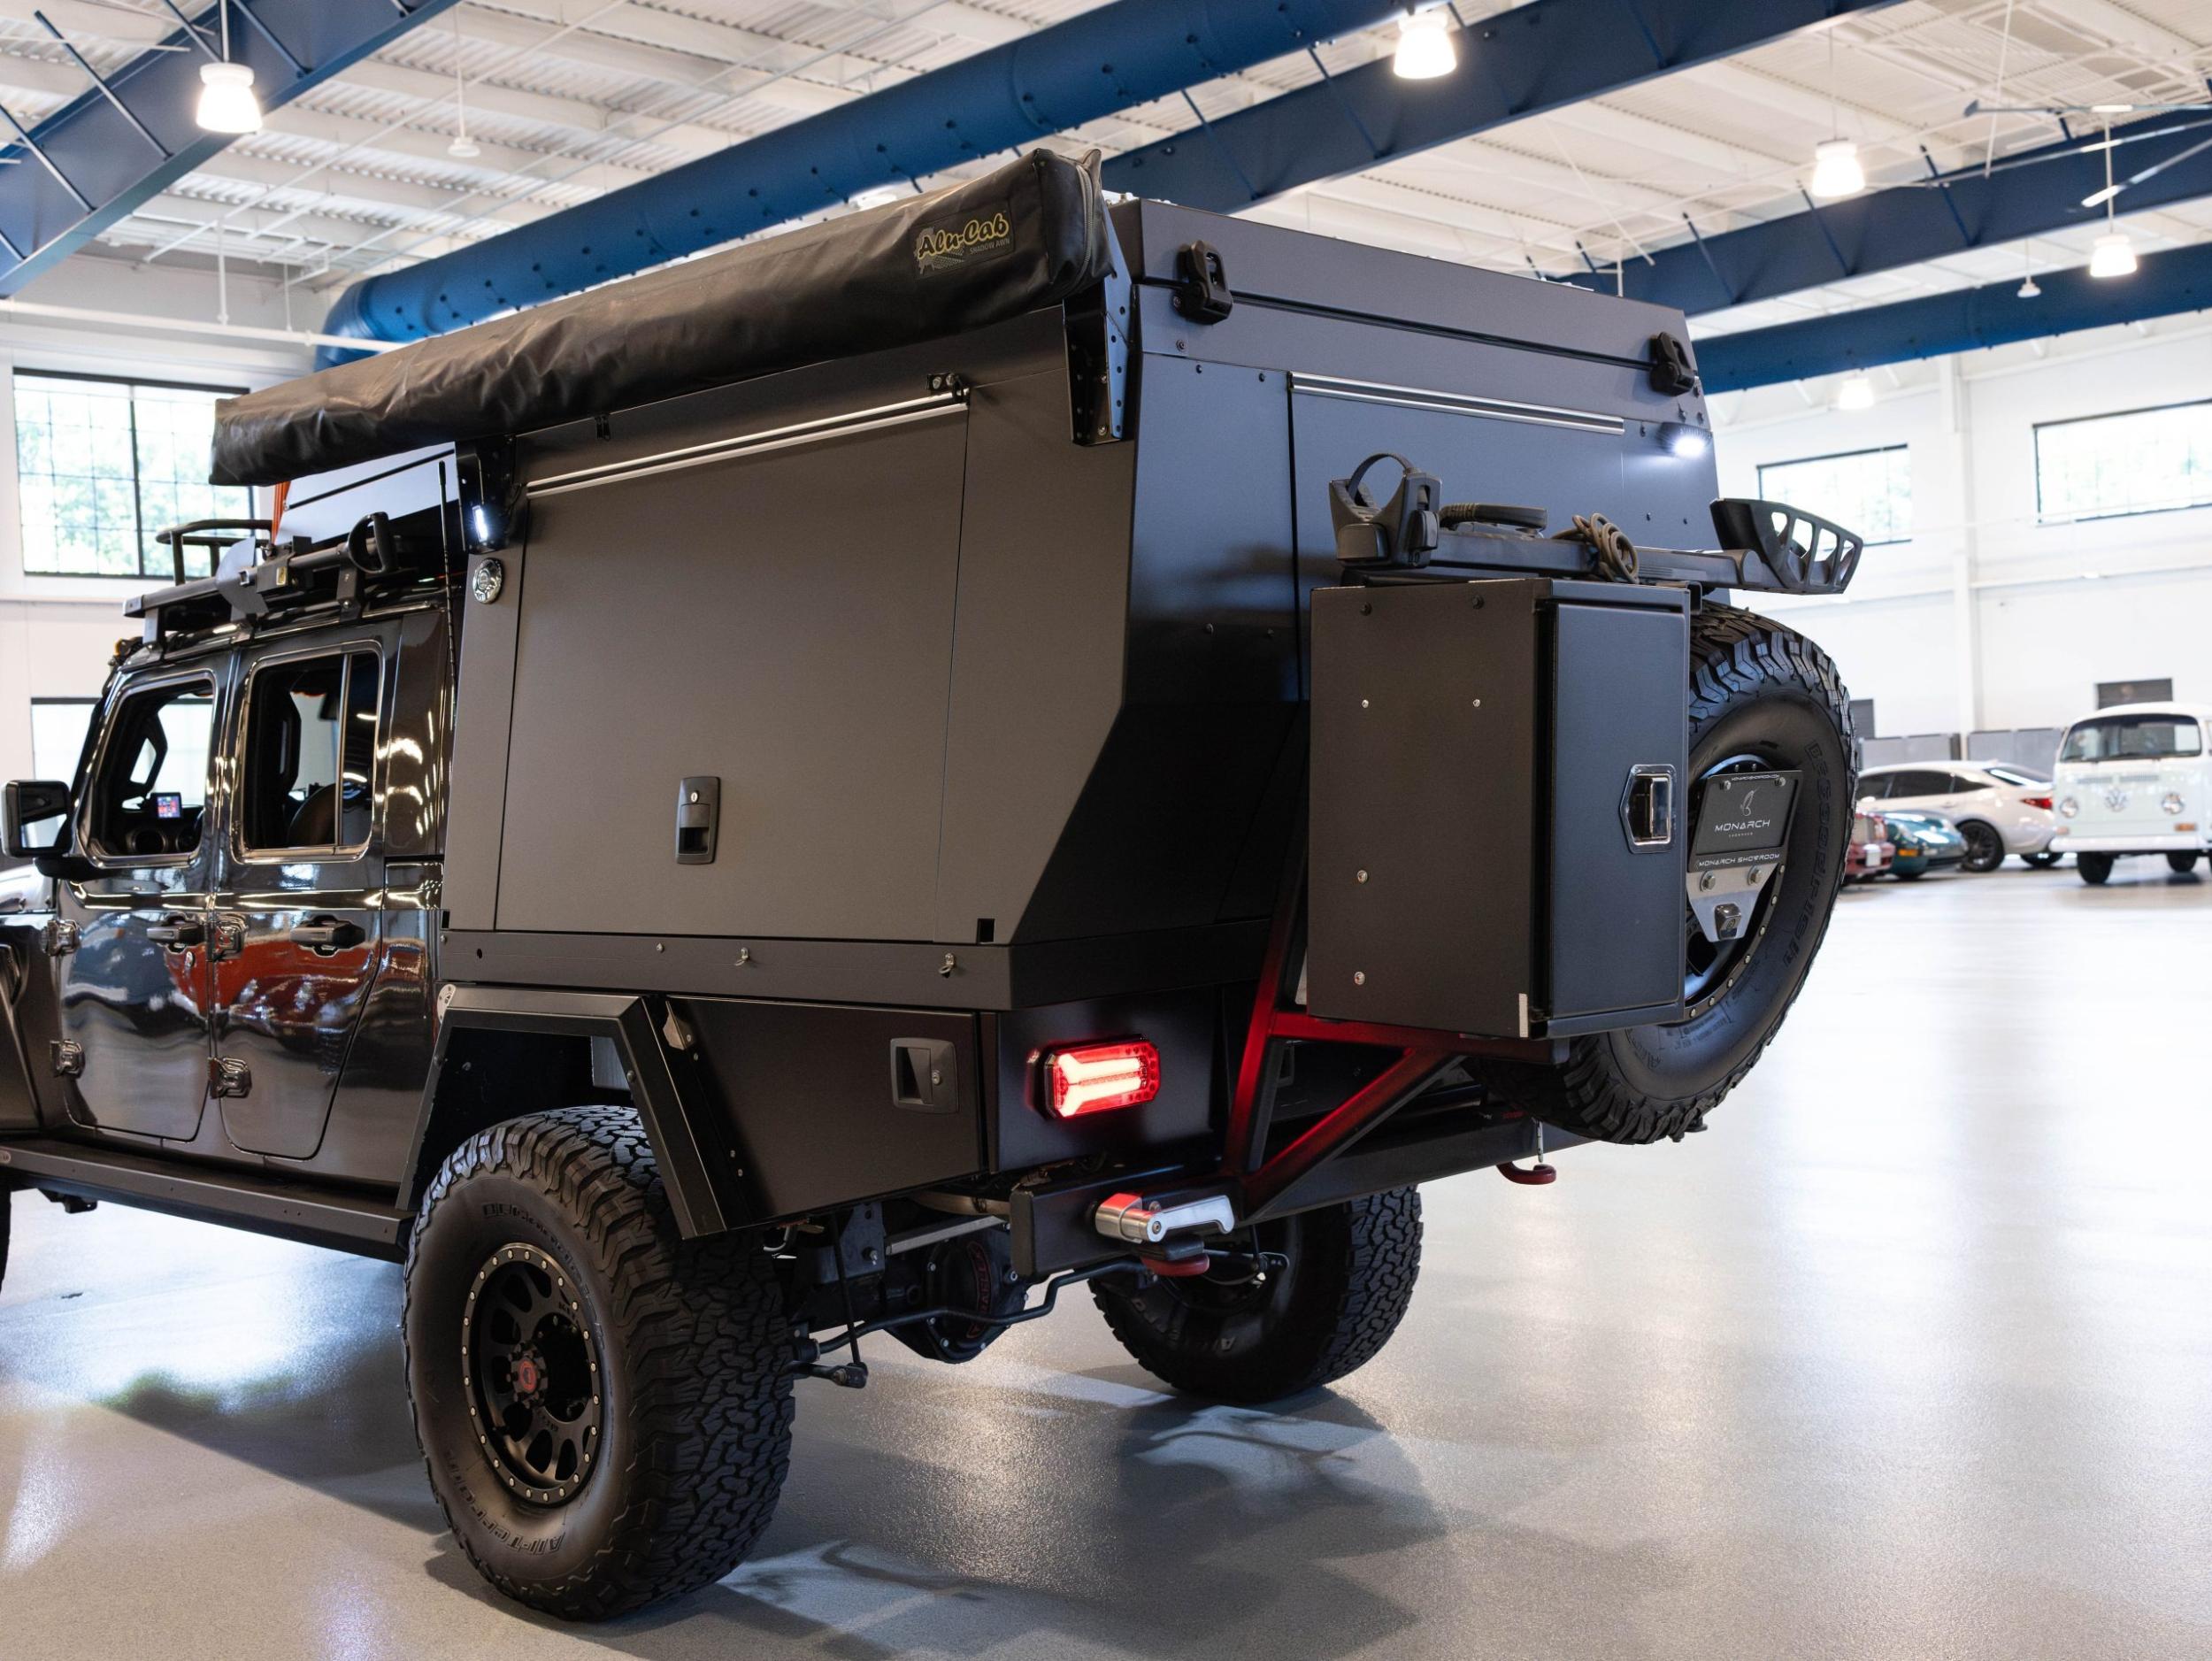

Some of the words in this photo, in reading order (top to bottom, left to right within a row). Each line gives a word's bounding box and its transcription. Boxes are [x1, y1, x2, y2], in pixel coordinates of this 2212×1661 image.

[918, 212, 1010, 260] Alu-Cab
[1714, 819, 1770, 832] MONARCH
[1698, 857, 1735, 866] MONARCH
[1737, 853, 1780, 863] SHOWROOM
[971, 1248, 990, 1334] TRAFLEX
